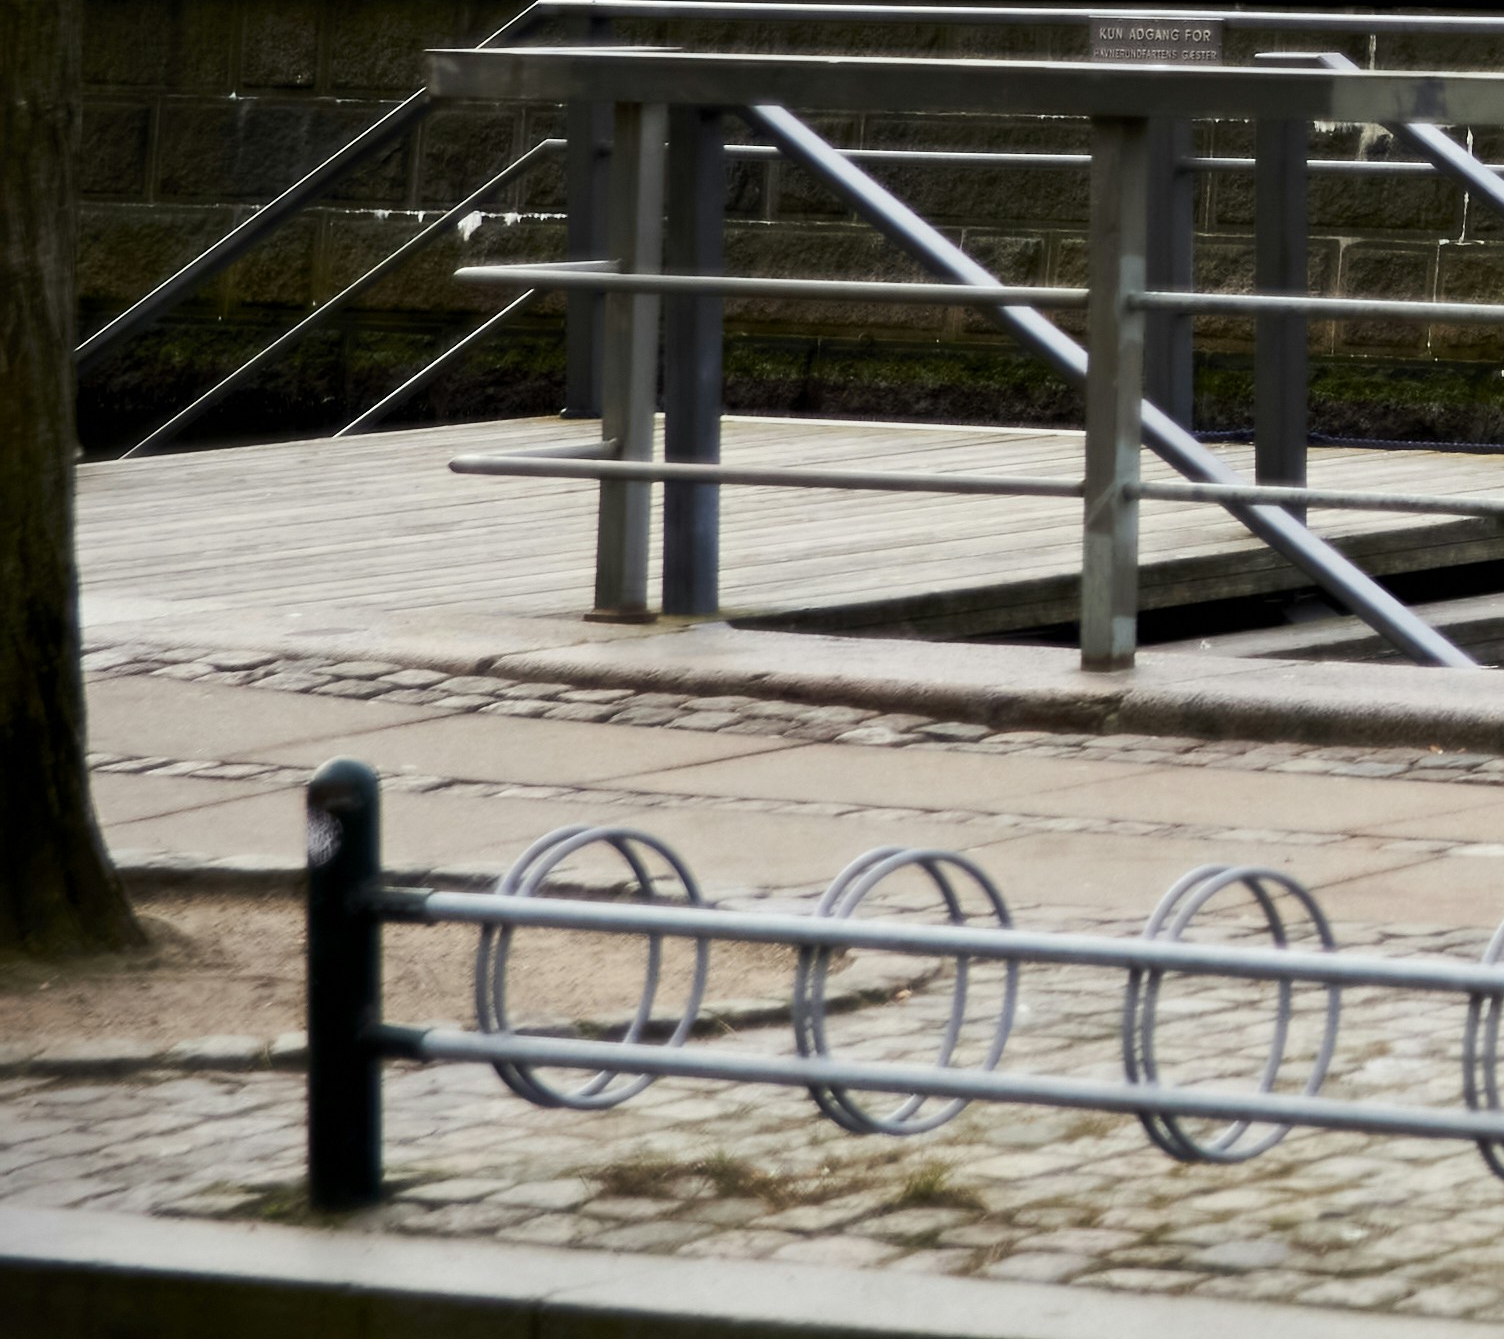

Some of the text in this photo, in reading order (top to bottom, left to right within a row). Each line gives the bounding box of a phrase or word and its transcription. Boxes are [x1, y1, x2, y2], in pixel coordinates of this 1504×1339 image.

[1100, 27, 1212, 42] KUN ADGANG FOR
